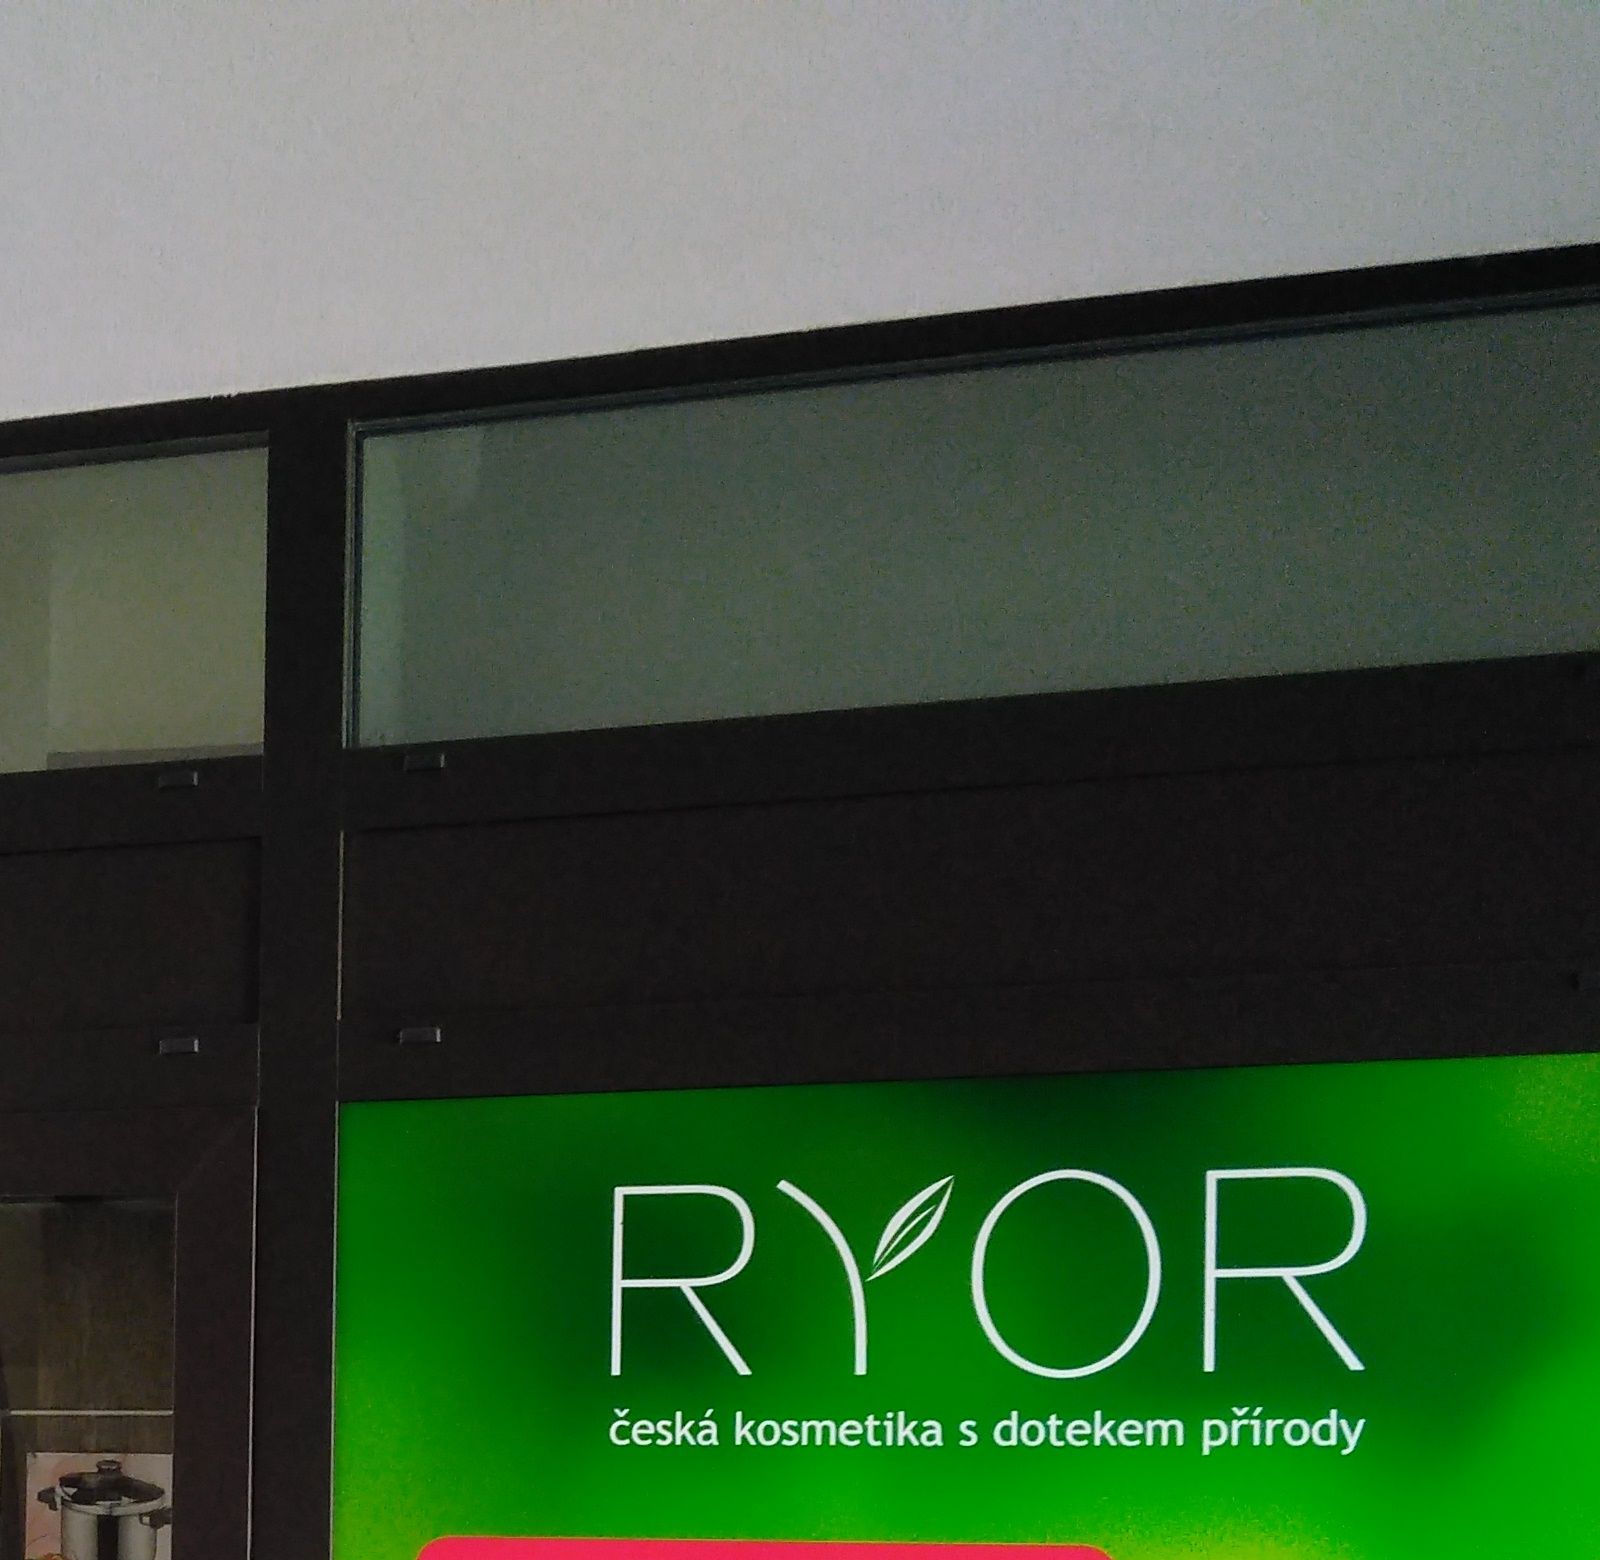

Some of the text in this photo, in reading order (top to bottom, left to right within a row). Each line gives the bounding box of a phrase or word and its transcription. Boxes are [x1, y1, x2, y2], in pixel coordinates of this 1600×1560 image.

[610, 1166, 1367, 1379] RYOR
[608, 1405, 1366, 1455] česká kosmetika s dotekem přírody
